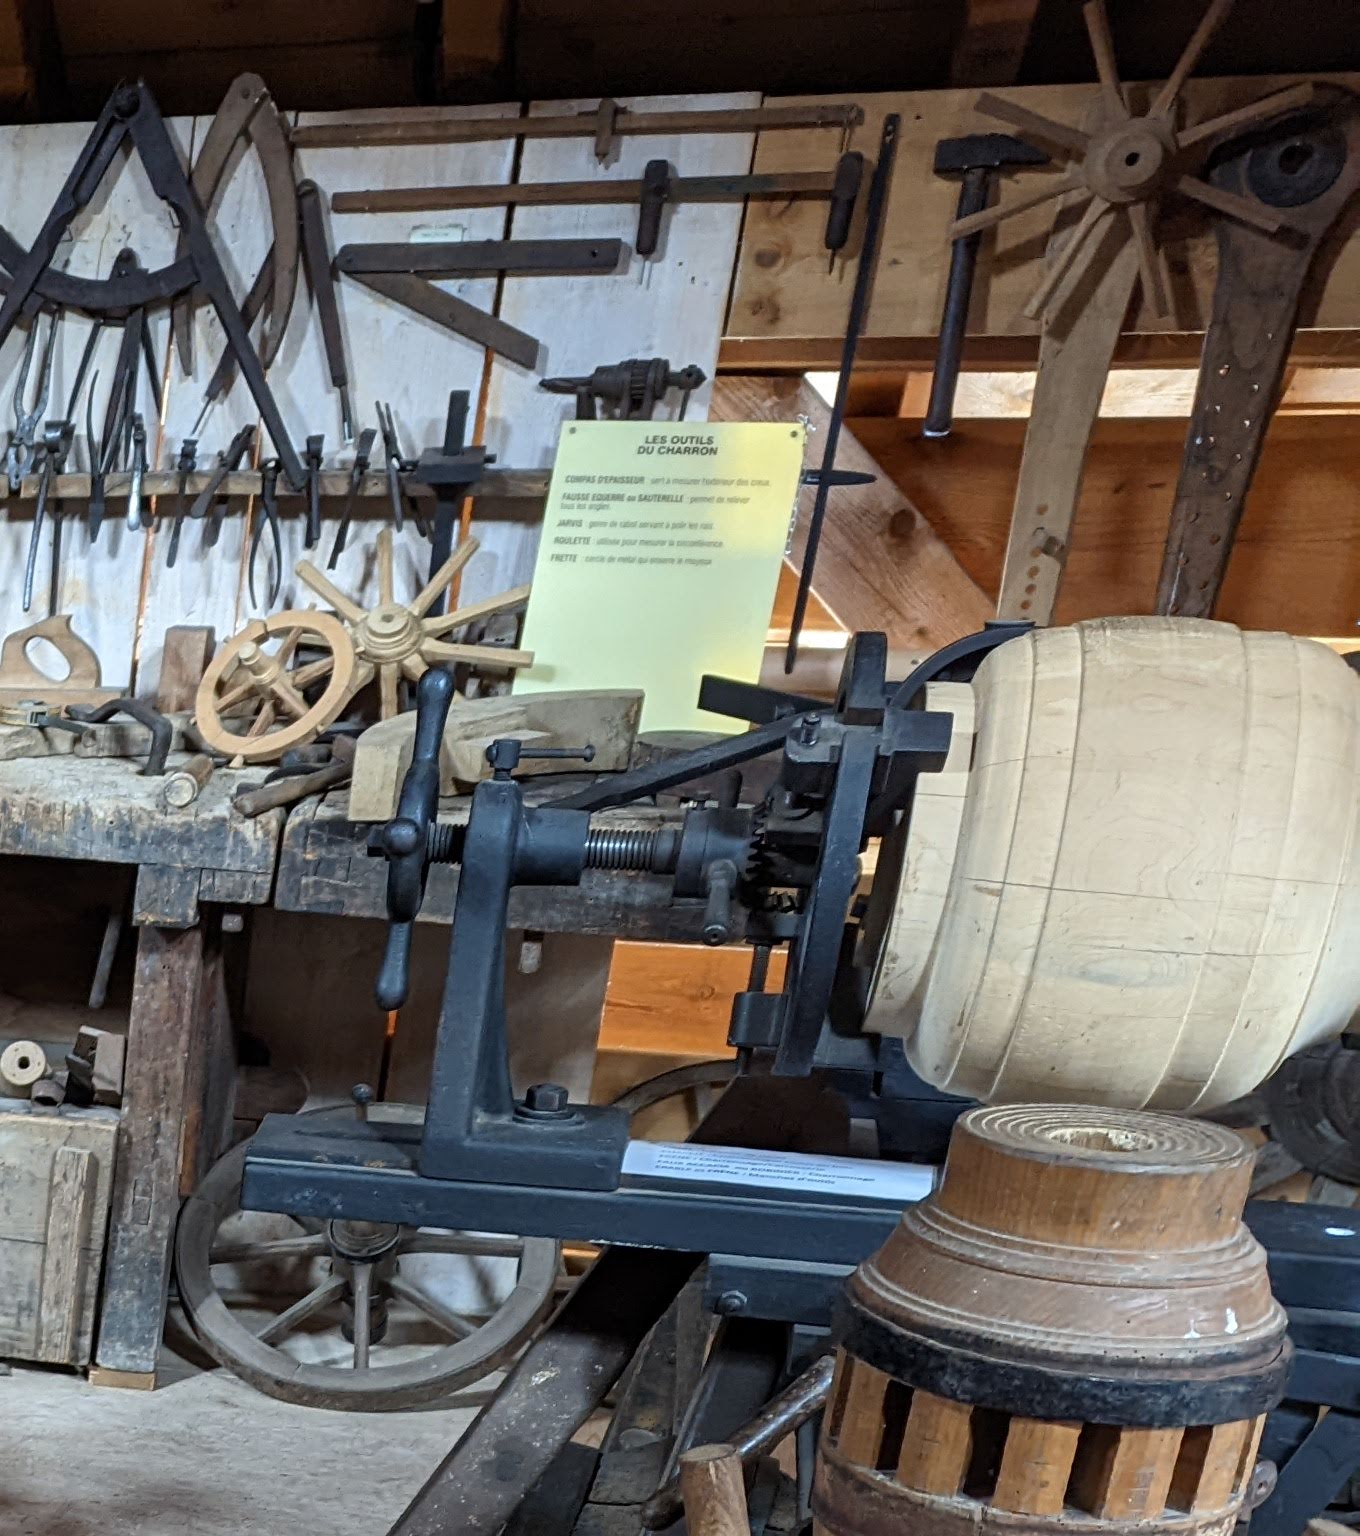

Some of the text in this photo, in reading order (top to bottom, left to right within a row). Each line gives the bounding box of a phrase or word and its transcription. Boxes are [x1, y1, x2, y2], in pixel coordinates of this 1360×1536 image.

[644, 435, 714, 445] LES OUTILS
[637, 446, 719, 456] DU CHARRON
